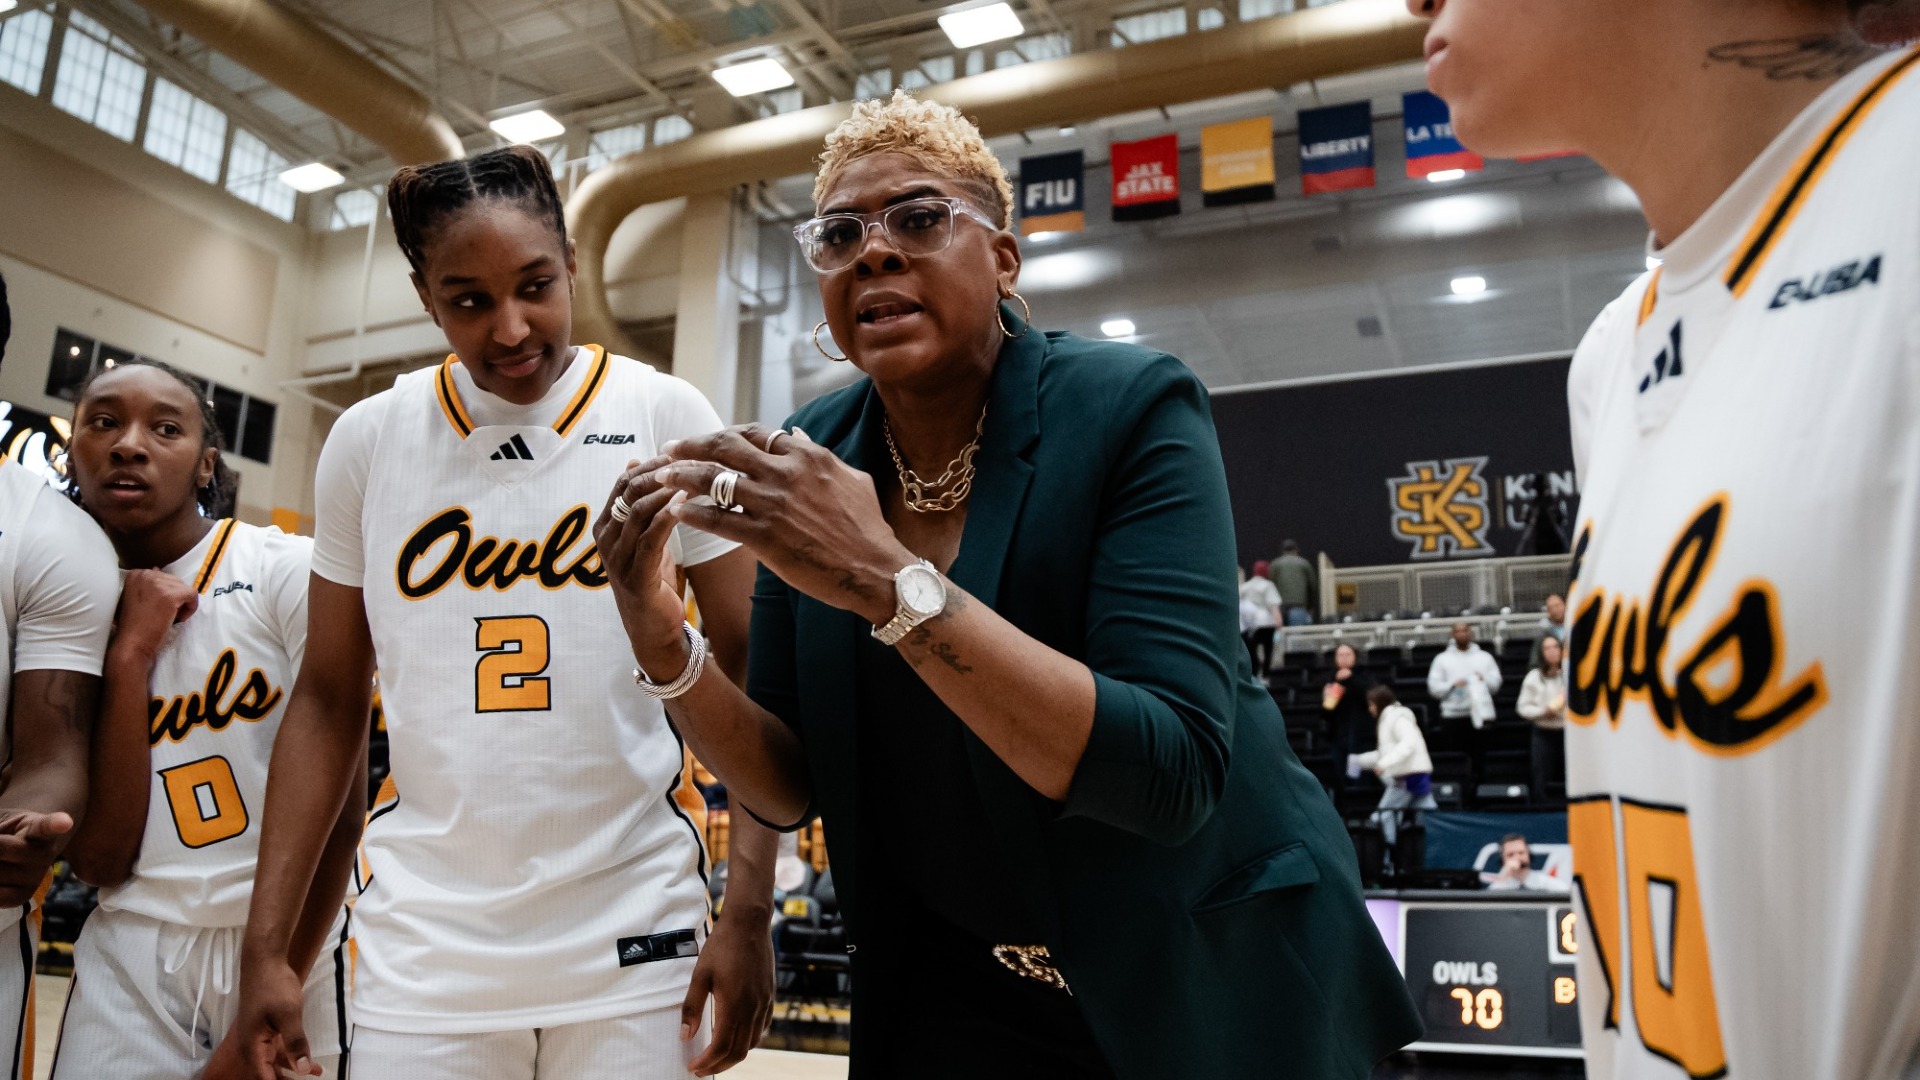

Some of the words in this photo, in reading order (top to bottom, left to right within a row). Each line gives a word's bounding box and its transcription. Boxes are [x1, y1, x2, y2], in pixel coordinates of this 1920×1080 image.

[1301, 135, 1371, 160] LIBERTY
[1117, 175, 1175, 199] STATE
[1126, 161, 1163, 181] JAX
[1025, 178, 1077, 210] FIU
[1566, 490, 1830, 758] wls
[473, 614, 551, 713] 2
[149, 646, 284, 748] wls
[156, 754, 249, 849] 0
[1432, 960, 1498, 985] OWLS
[1450, 988, 1503, 1030] 70
